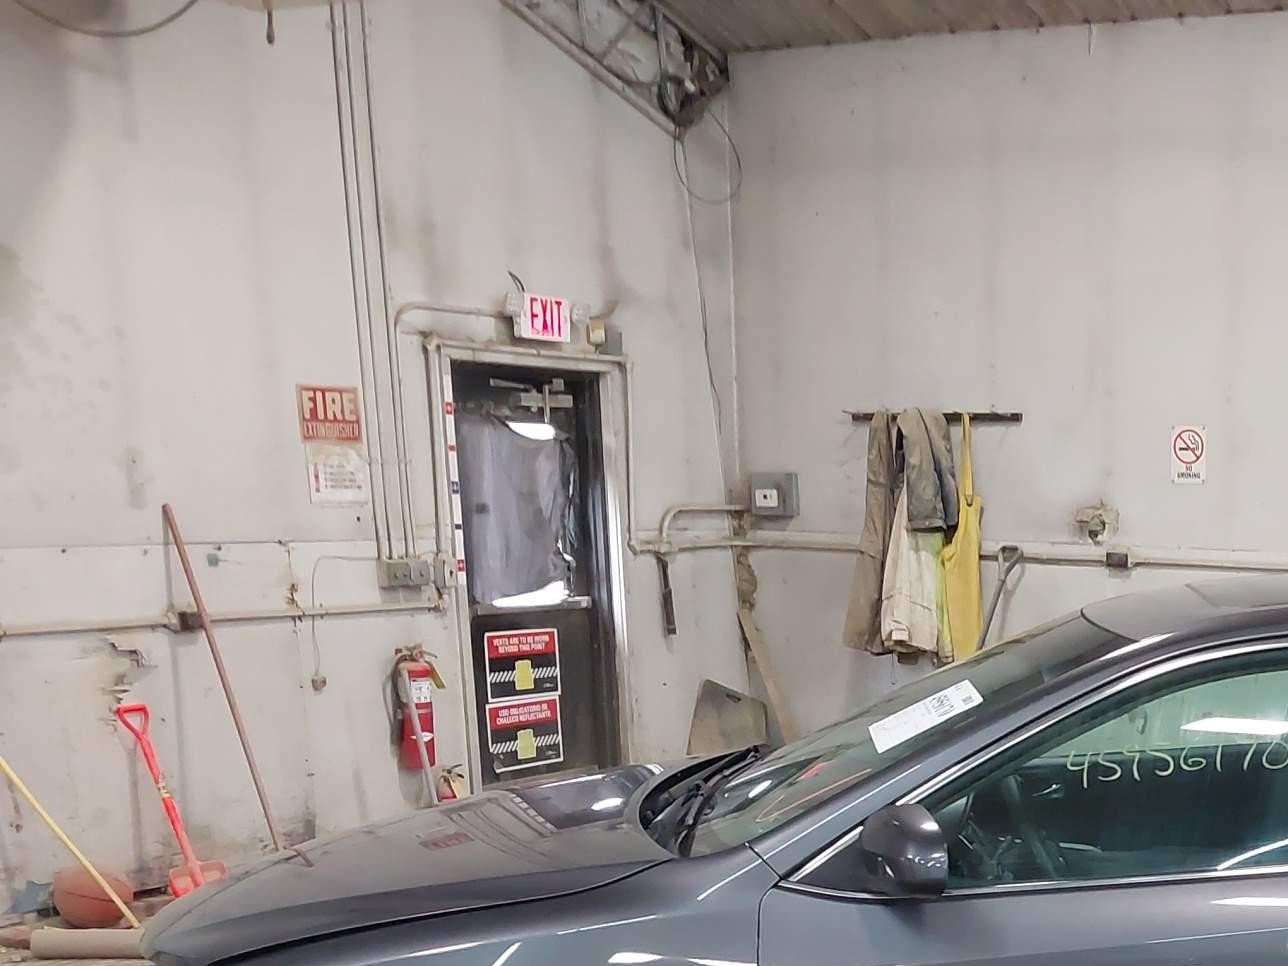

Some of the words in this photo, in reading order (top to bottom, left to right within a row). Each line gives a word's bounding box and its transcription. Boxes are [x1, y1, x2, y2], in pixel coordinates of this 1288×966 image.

[530, 297, 562, 337] EXIT
[302, 389, 357, 421] FIRE
[303, 421, 359, 438] EXTINGUISHER
